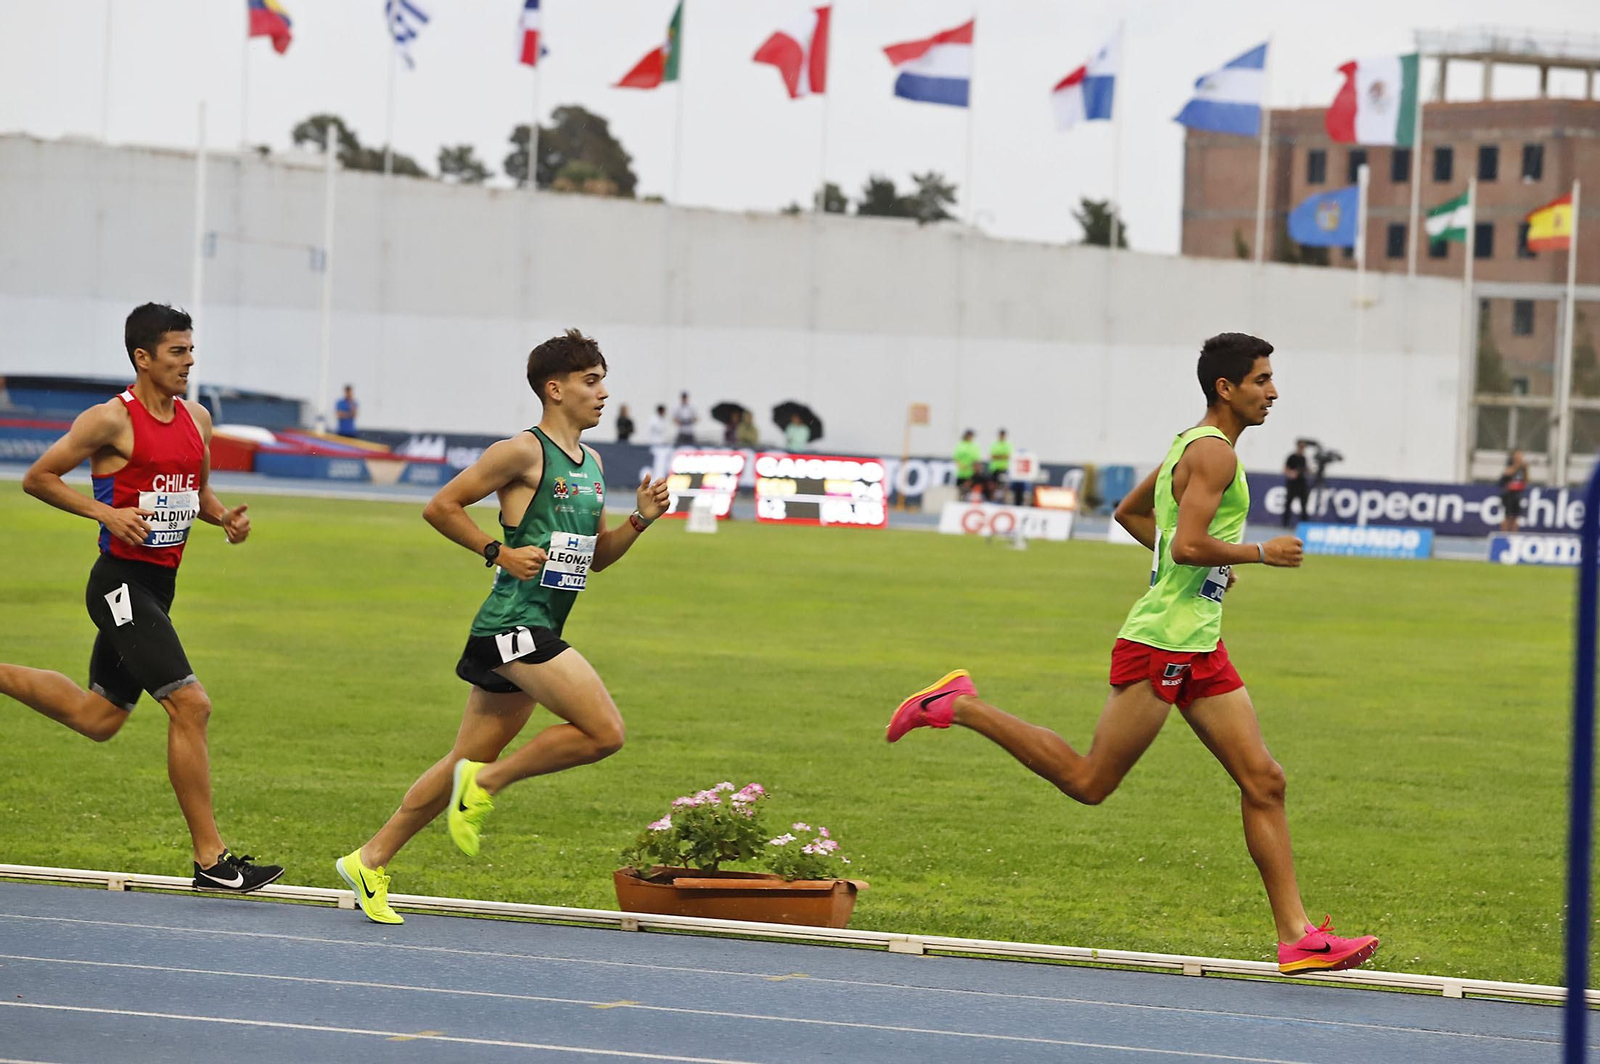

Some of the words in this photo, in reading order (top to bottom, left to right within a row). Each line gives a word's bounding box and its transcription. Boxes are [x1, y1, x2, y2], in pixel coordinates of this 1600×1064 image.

[152, 473, 195, 493] CHILE
[168, 522, 177, 530] 89
[1325, 526, 1420, 549] MONDO
[1500, 535, 1582, 565] Jom
[575, 565, 586, 574] 82
[558, 574, 586, 587] Jom
